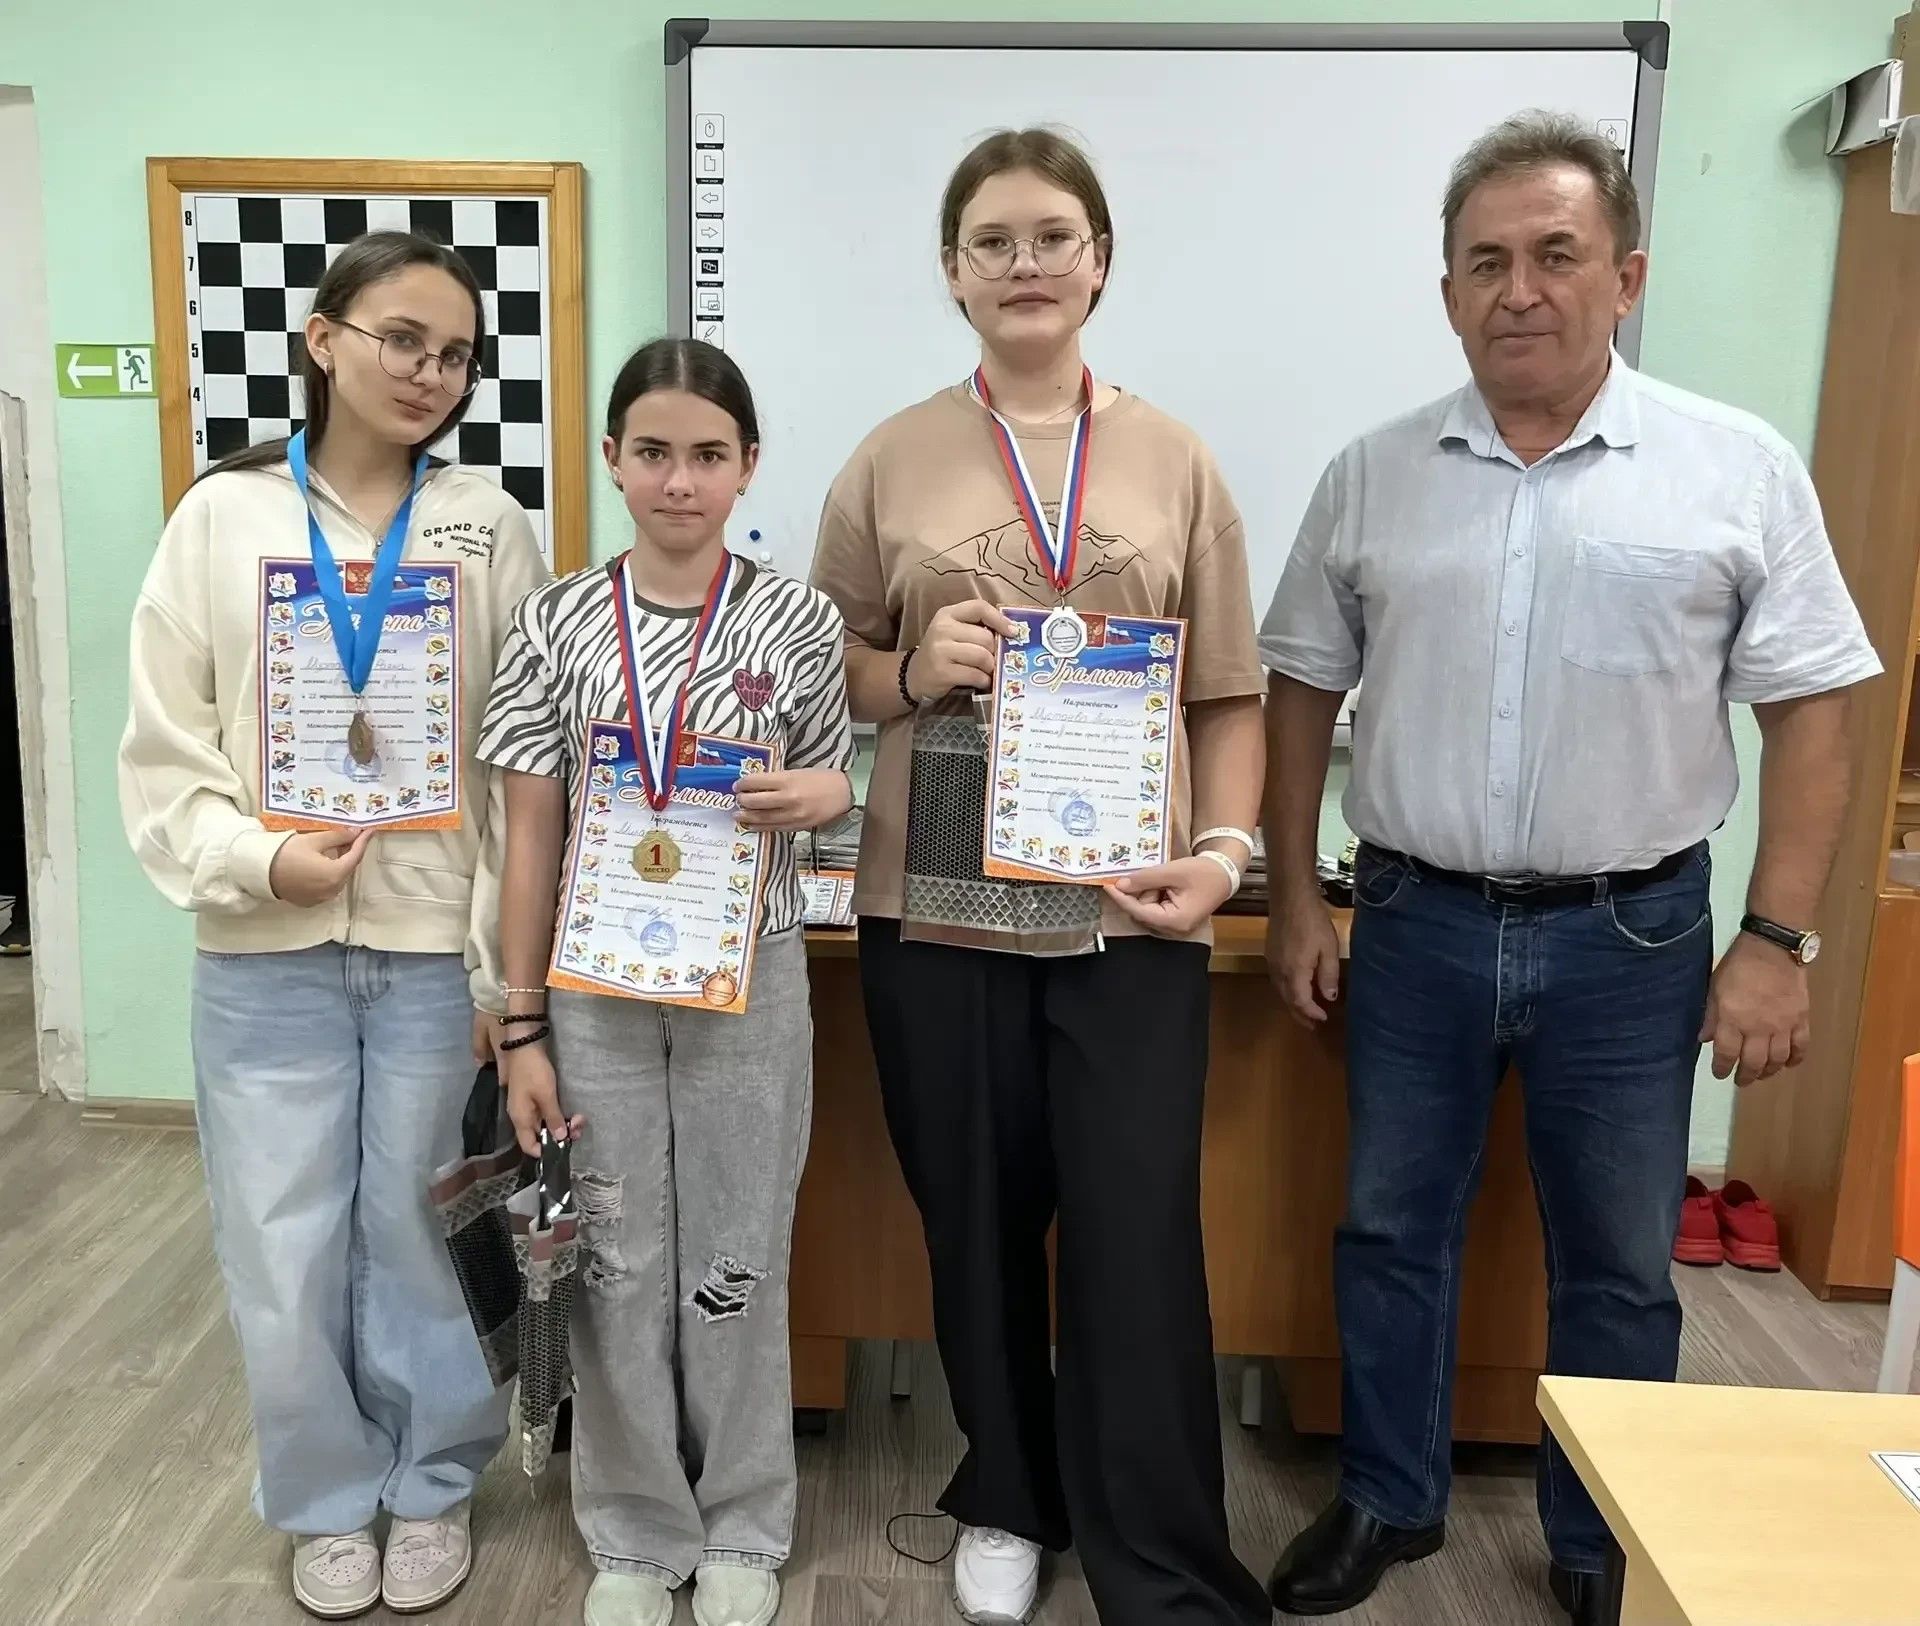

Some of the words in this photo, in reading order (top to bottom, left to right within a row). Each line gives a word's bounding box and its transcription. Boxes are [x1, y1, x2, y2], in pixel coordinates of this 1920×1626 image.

[184, 210, 193, 226] 8
[187, 256, 194, 272] 7
[189, 300, 197, 316] 6
[191, 343, 199, 359] 5
[192, 387, 201, 402] 4
[196, 430, 204, 445] 3
[423, 523, 472, 538] GRAND
[433, 540, 443, 549] 19
[450, 534, 480, 546] NATIONAL
[1030, 652, 1146, 693] Грамота
[735, 671, 773, 692] GOOD
[650, 844, 661, 866] 1
